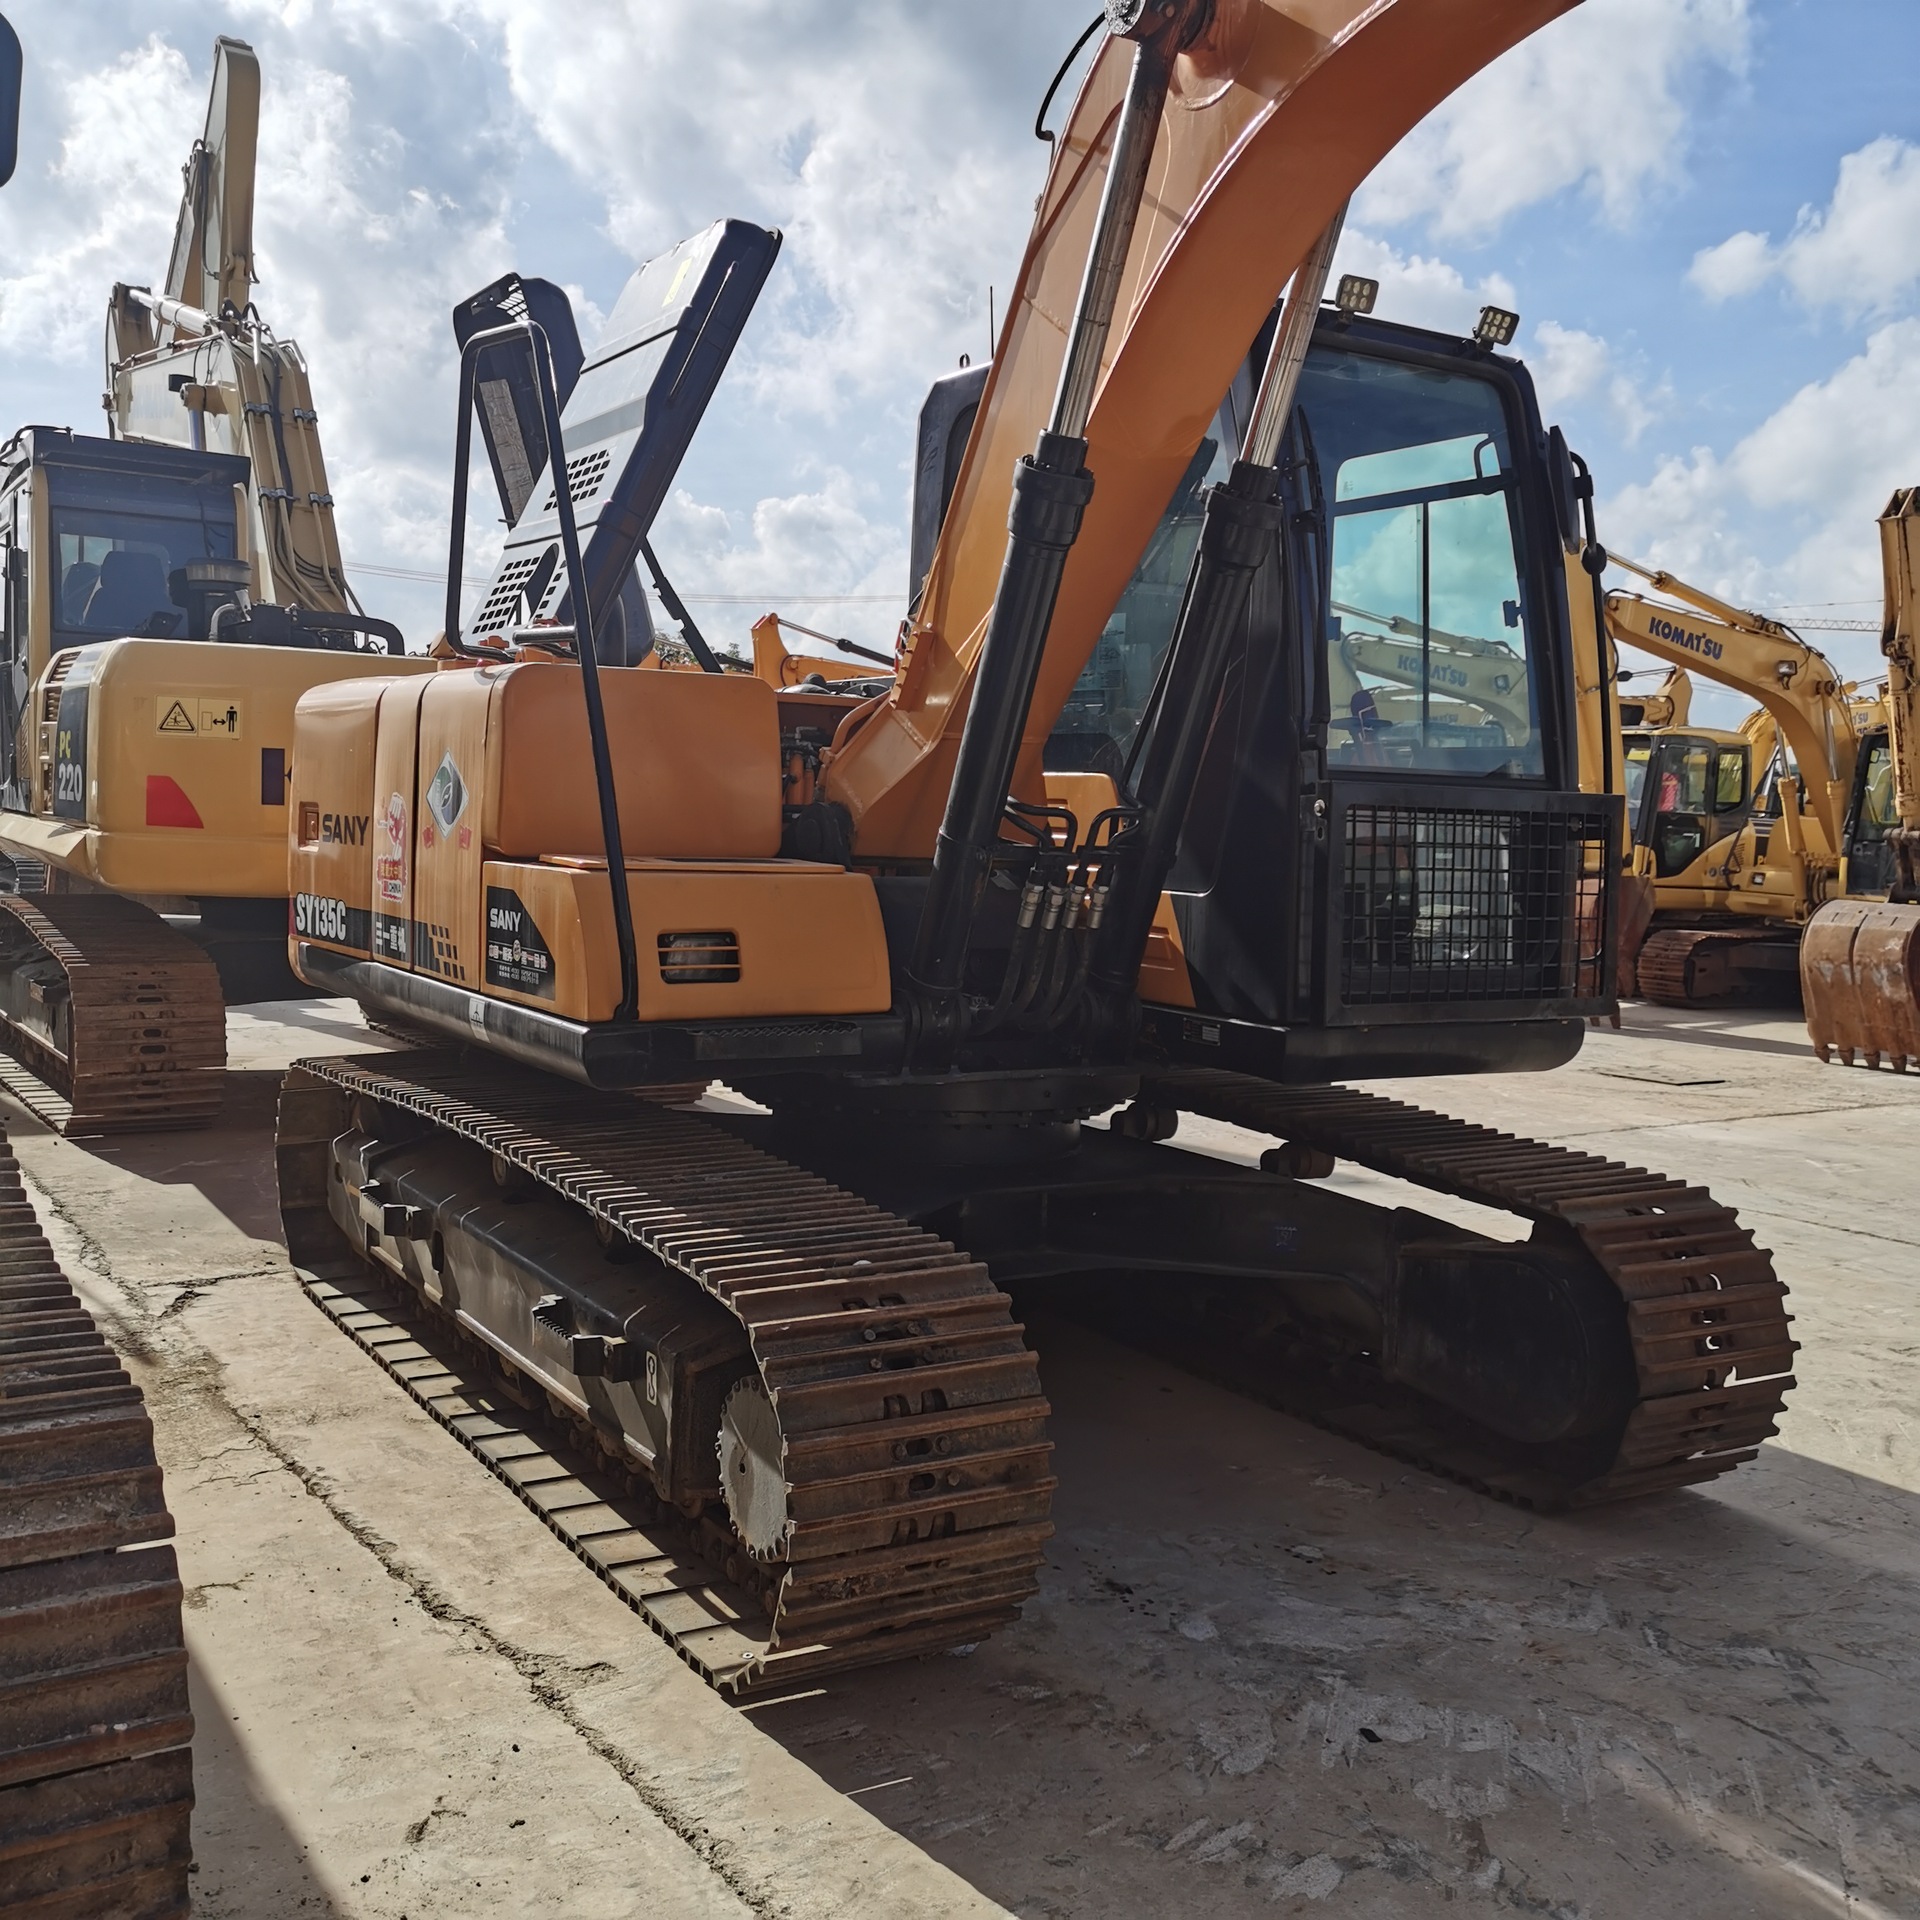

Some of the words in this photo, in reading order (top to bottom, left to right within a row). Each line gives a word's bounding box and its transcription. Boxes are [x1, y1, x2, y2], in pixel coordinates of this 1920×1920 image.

[1649, 616, 1723, 661] KOMATSU
[1397, 654, 1467, 688] KOATSU
[59, 730, 71, 759] PC
[58, 763, 82, 802] 220
[322, 813, 369, 846] SANY
[295, 892, 347, 941] SY135C
[490, 907, 521, 933] SANY
[375, 921, 406, 954] 三一重机
